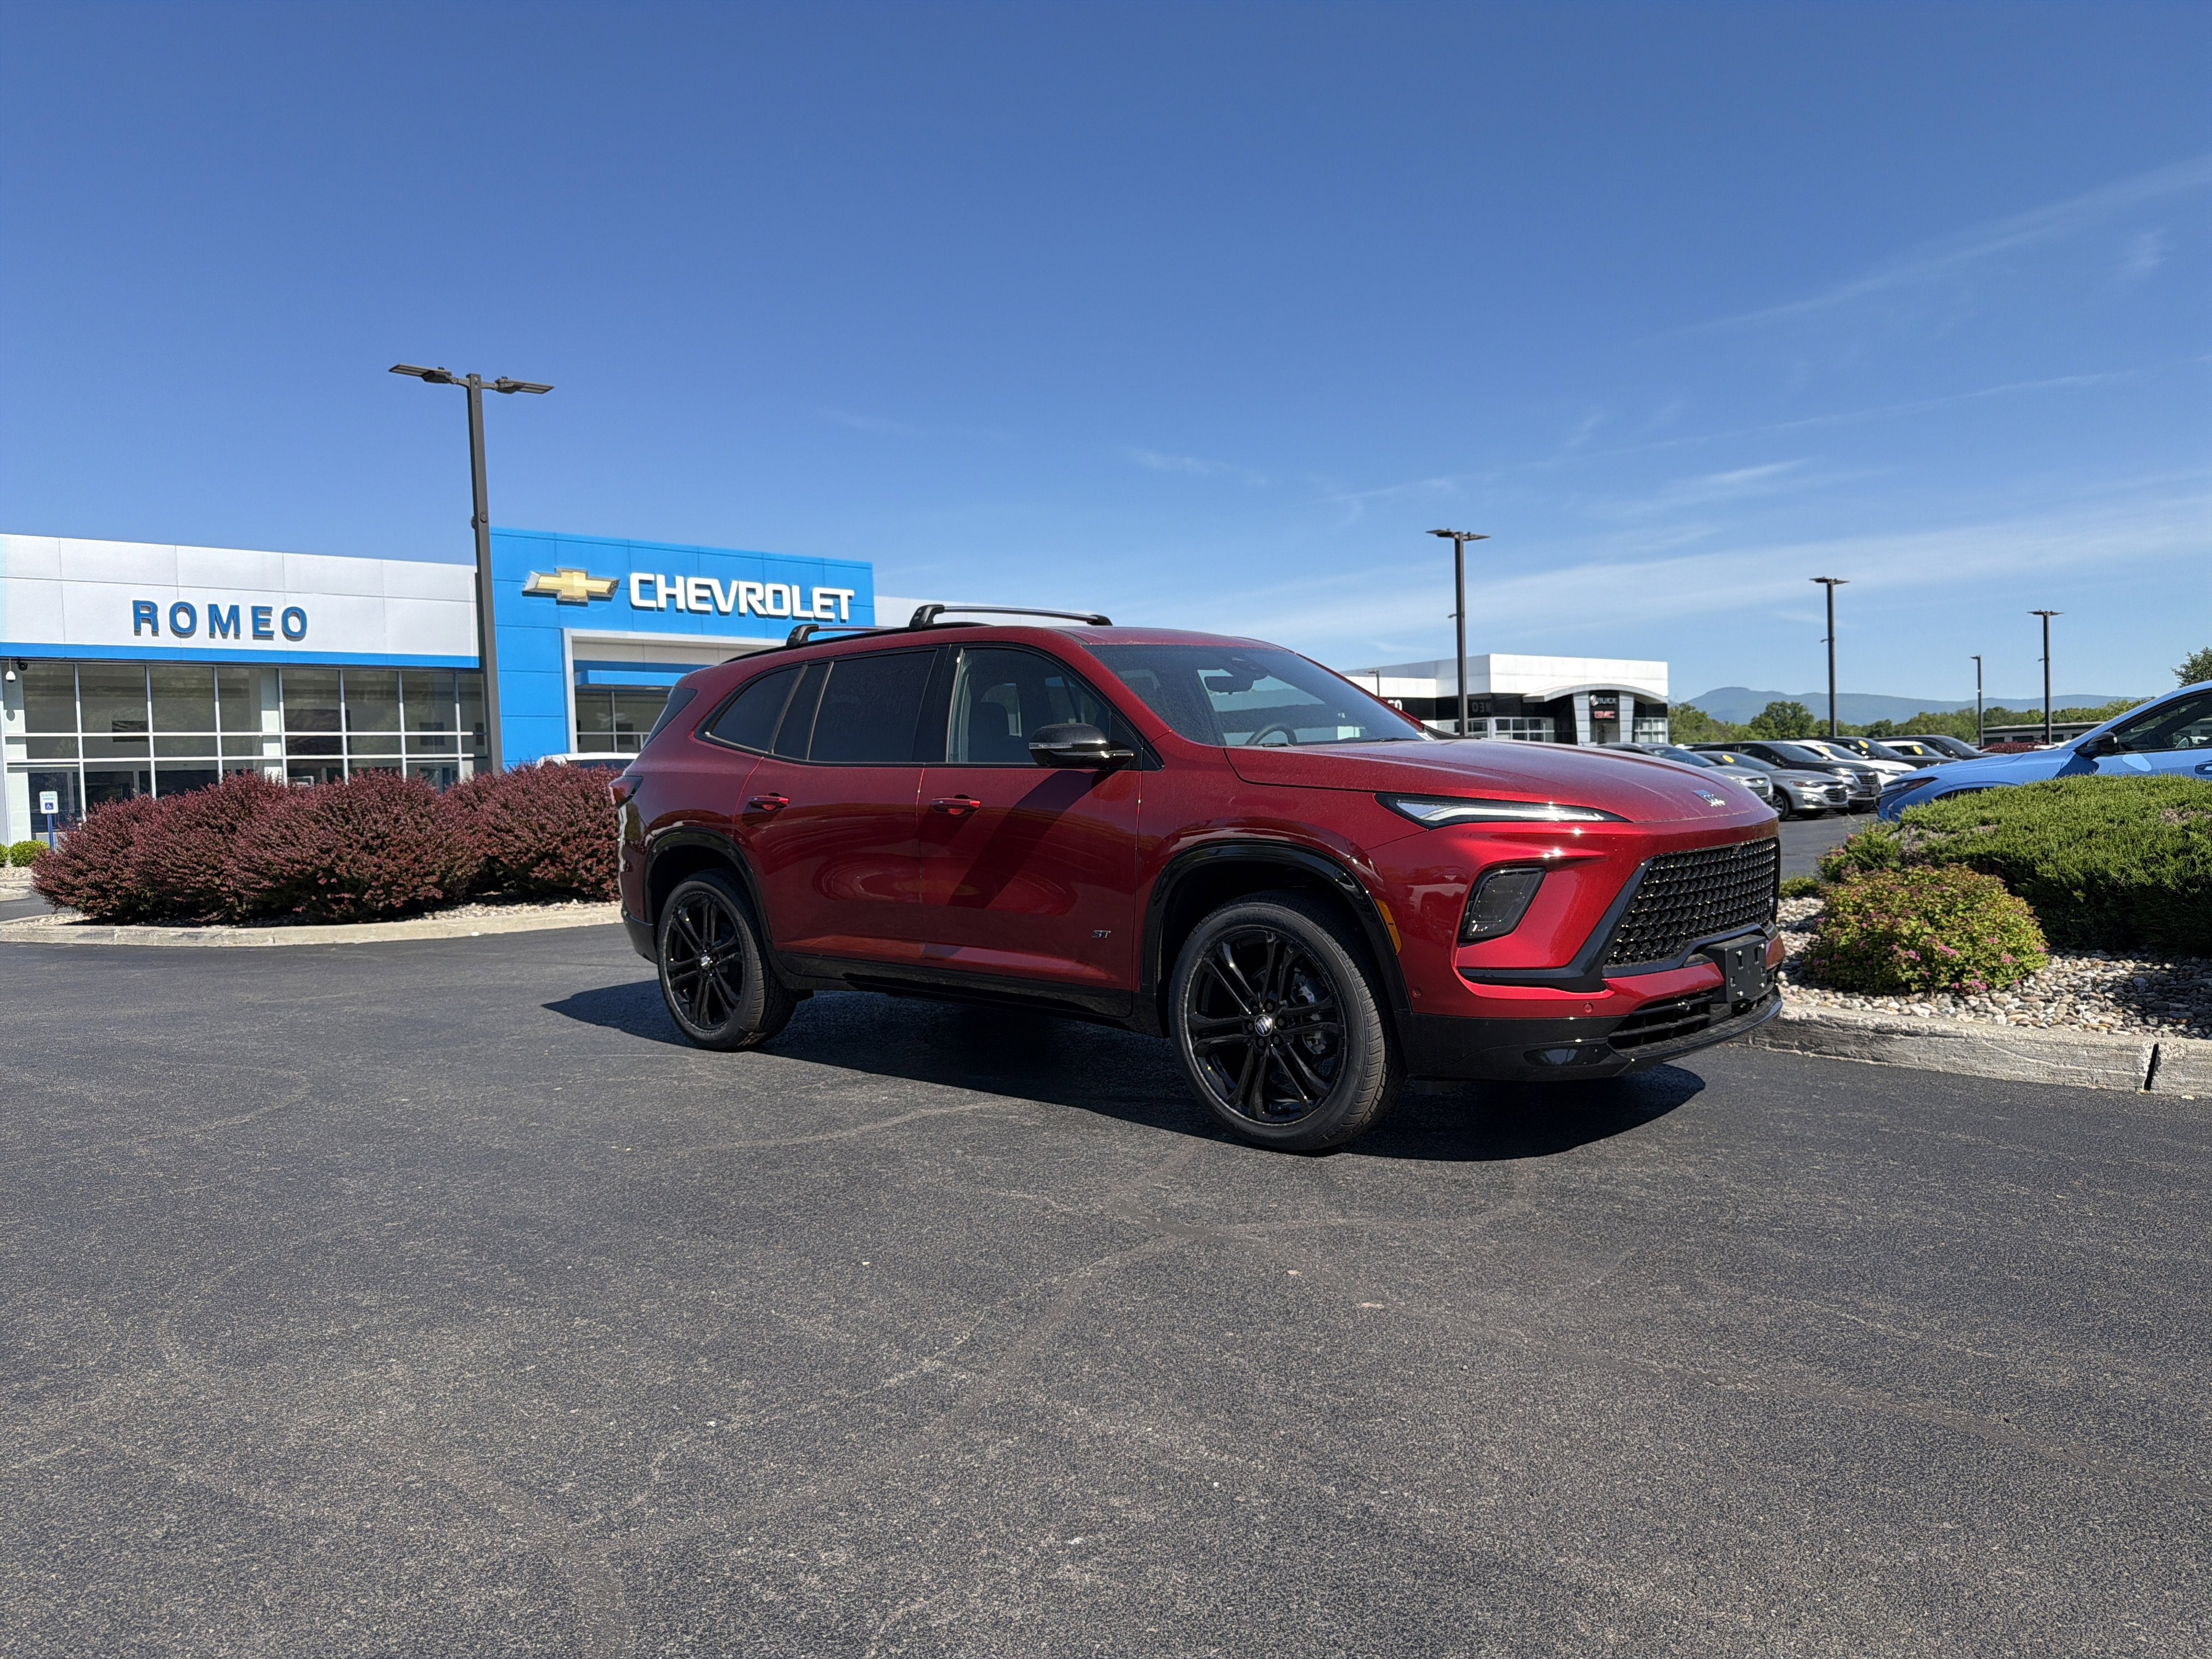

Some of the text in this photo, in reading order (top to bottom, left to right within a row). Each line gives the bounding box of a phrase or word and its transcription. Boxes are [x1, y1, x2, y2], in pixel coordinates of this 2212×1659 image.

[629, 572, 855, 620] CHEVROLET
[132, 600, 308, 639] ROMEO
[1092, 930, 1111, 939] ST
